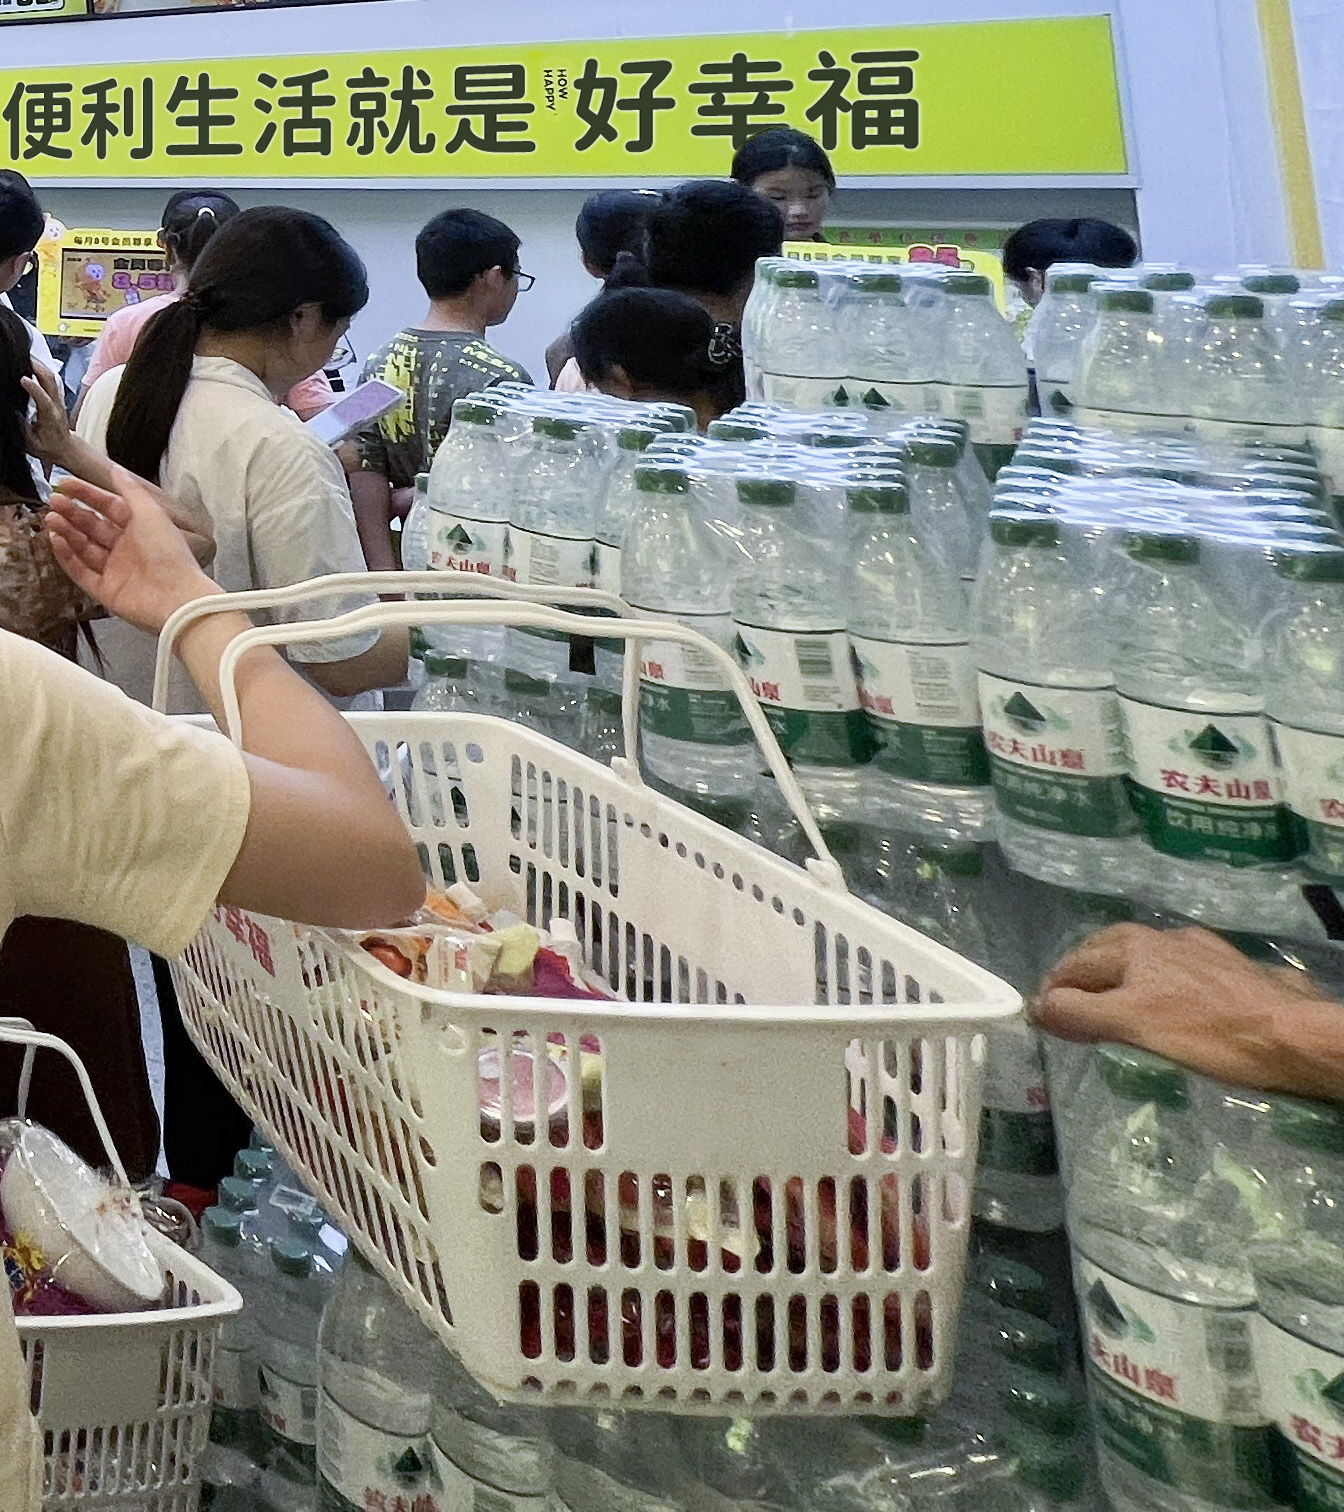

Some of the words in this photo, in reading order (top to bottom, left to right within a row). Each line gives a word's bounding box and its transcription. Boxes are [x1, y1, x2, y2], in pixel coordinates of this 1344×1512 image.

[543, 69, 556, 110] HAPPY
[556, 68, 569, 99] HOW
[2, 62, 537, 163] 便利生活就是
[572, 48, 921, 152] 好幸福
[988, 730, 1087, 771] 农夫山泉
[1160, 768, 1273, 802] 农夫山泉
